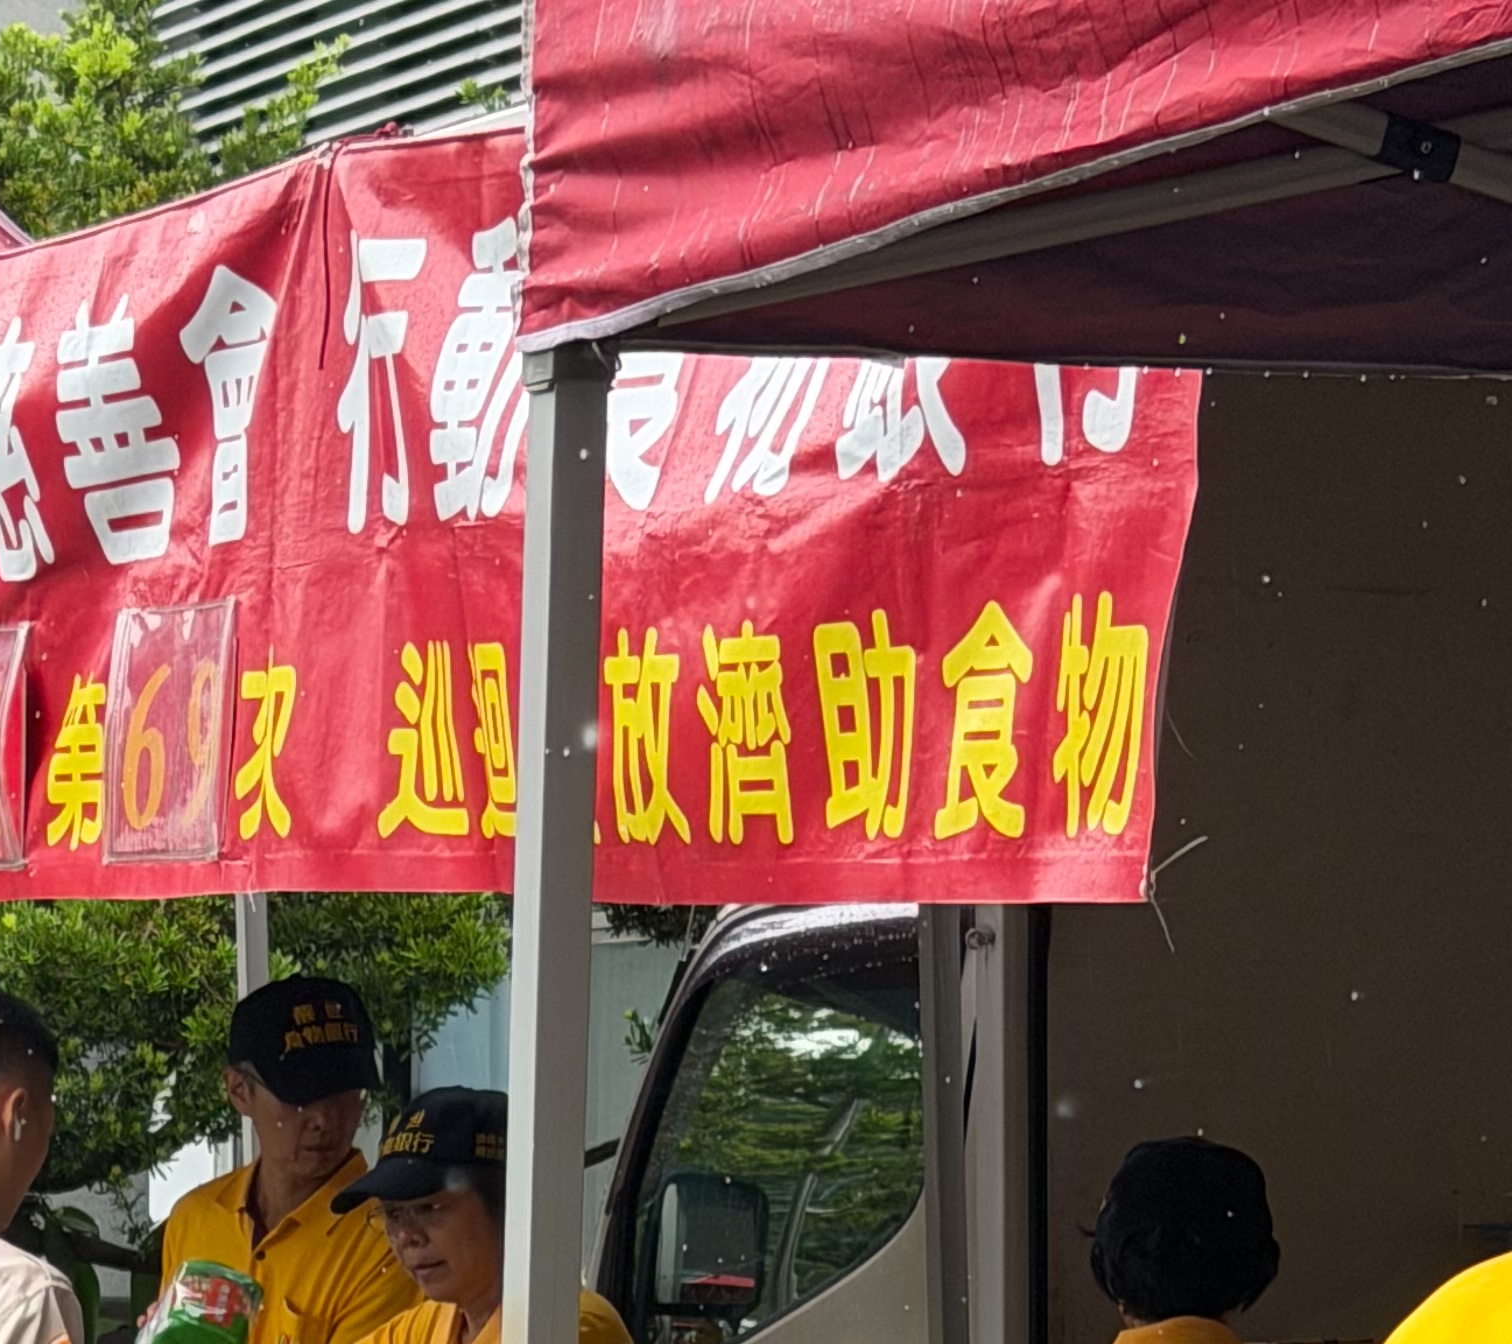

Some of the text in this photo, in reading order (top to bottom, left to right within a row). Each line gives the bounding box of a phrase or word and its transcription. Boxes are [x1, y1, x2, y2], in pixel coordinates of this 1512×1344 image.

[377, 590, 1150, 845] 巡迴放濟助食物
